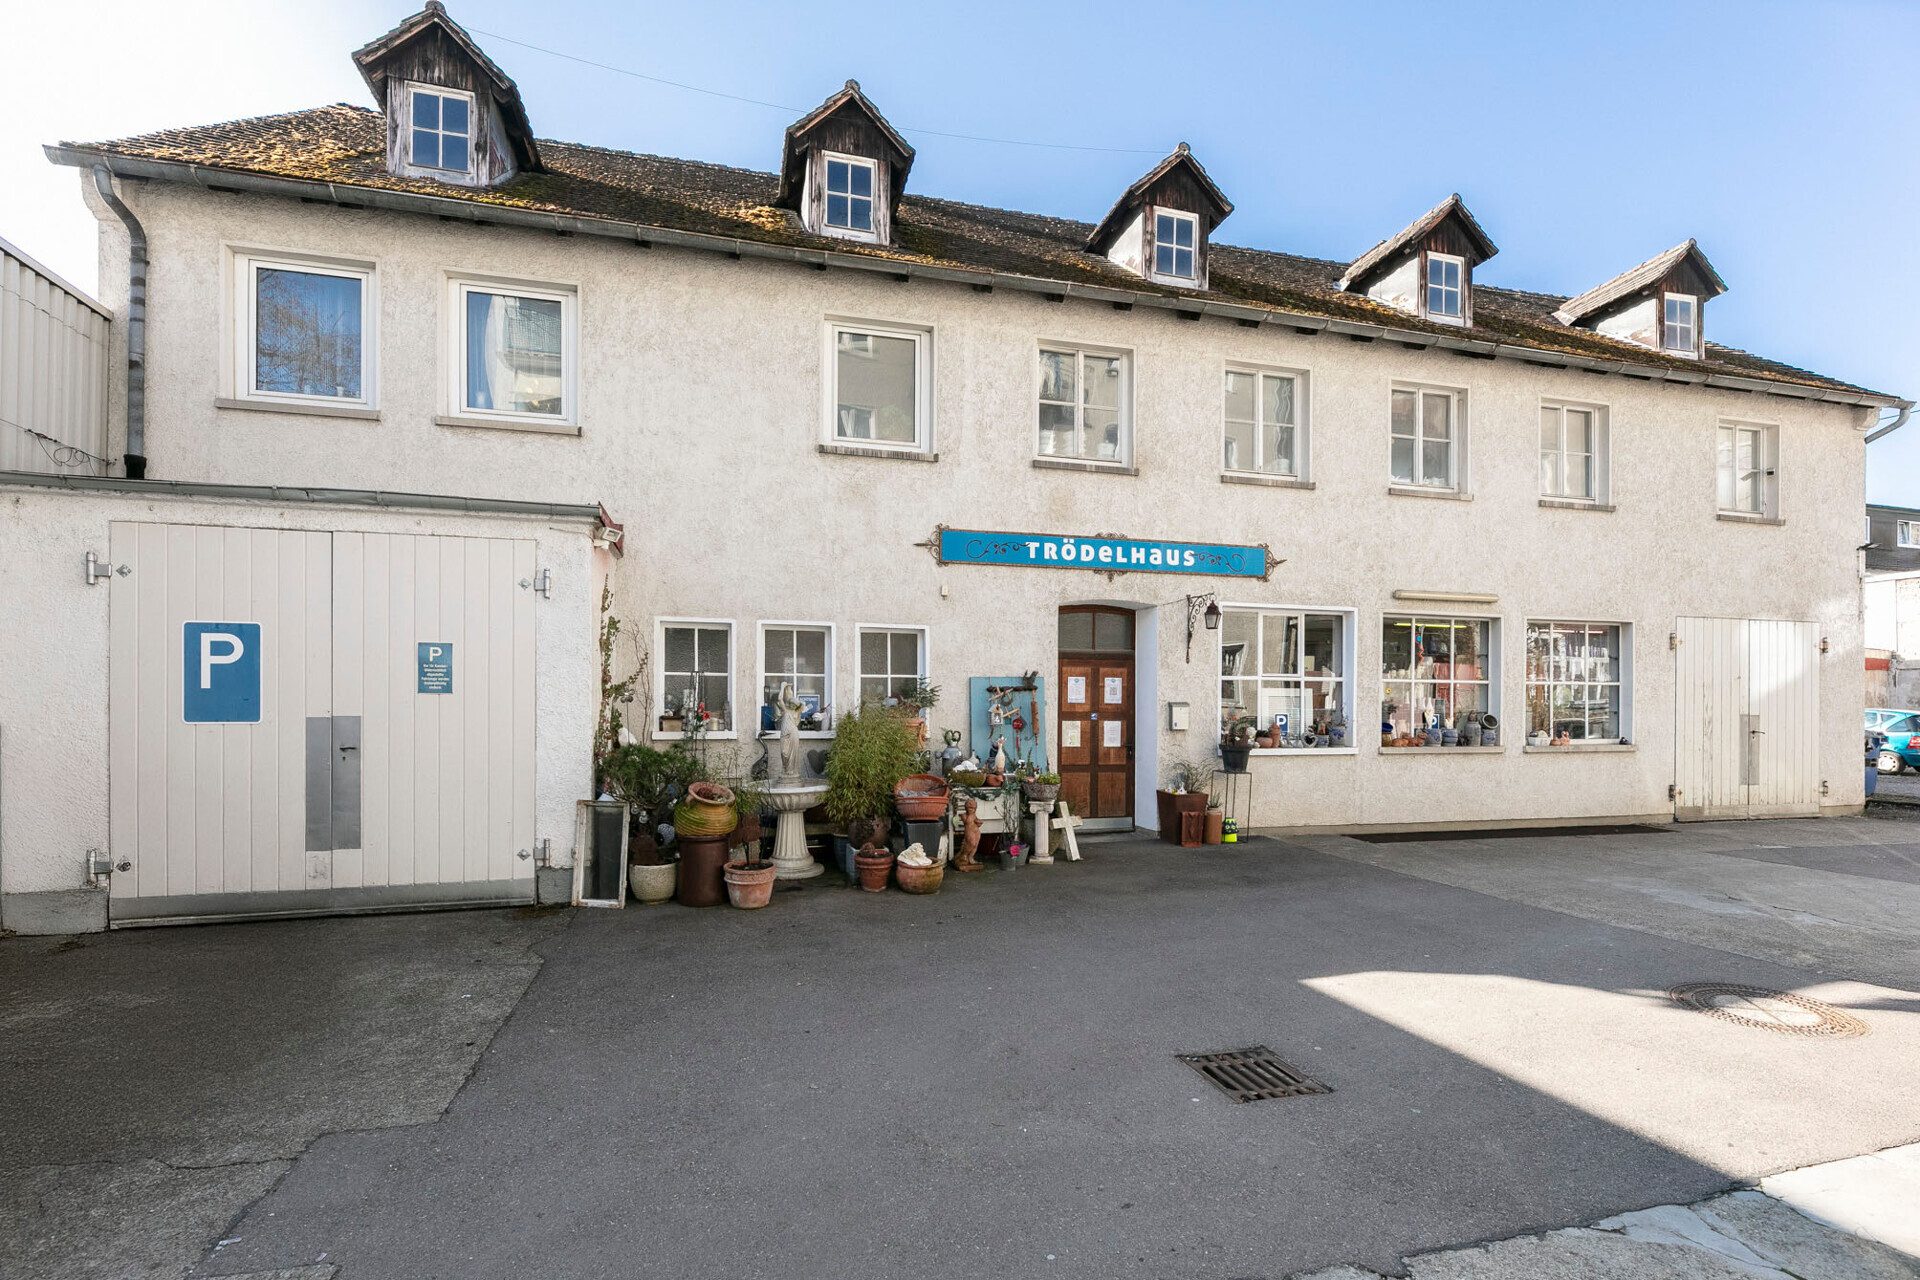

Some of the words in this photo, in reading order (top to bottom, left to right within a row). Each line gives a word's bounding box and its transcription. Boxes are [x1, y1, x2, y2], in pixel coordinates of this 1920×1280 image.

[200, 632, 244, 689] P
[429, 646, 443, 662] P
[1276, 715, 1287, 727] P
